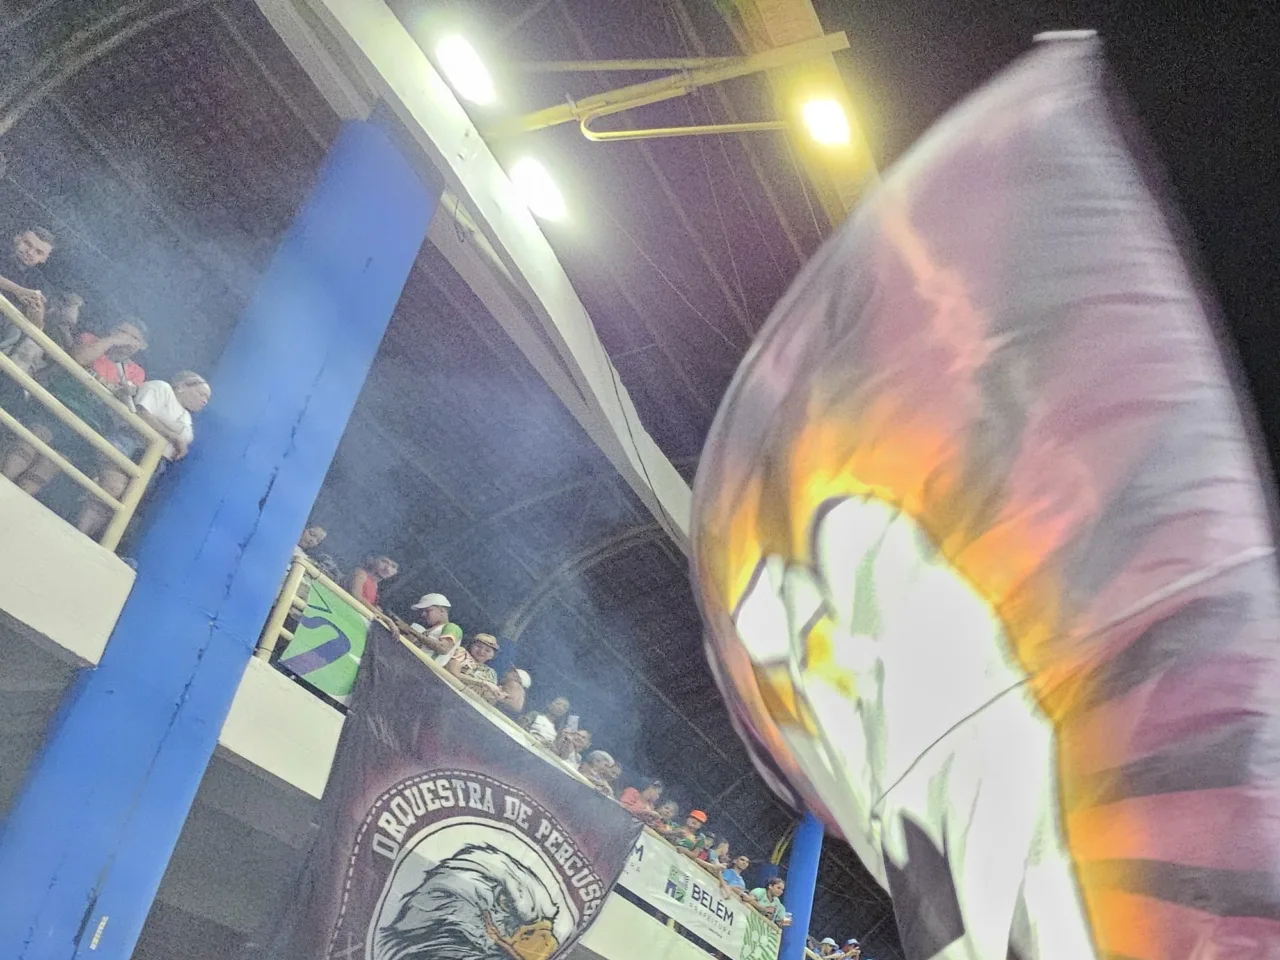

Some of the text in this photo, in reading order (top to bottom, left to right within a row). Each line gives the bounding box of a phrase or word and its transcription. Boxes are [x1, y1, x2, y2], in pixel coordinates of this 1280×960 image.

[372, 778, 495, 860] ORQUESTRA
[504, 794, 532, 831] DE
[691, 883, 734, 926] BELÉM
